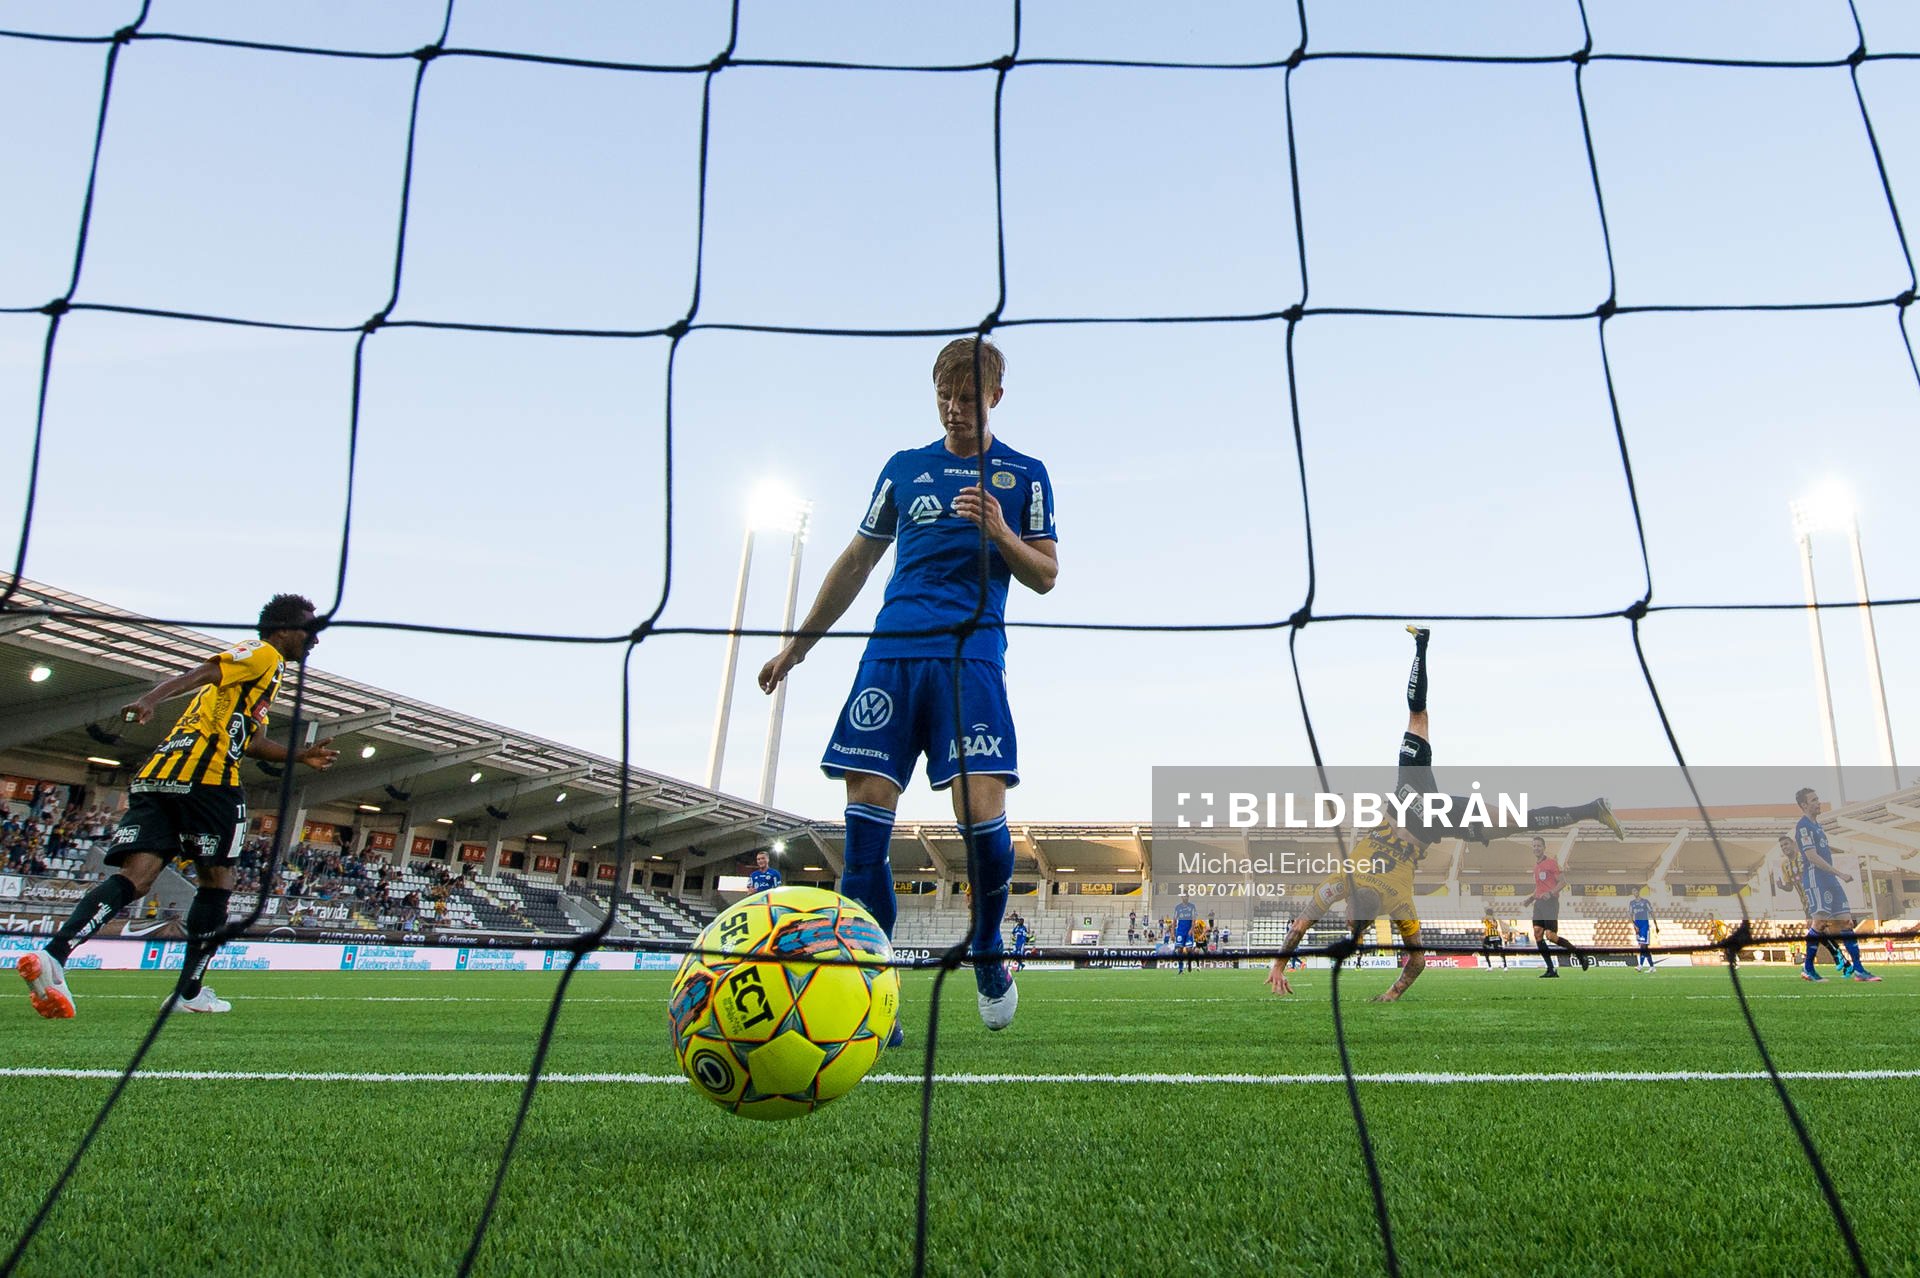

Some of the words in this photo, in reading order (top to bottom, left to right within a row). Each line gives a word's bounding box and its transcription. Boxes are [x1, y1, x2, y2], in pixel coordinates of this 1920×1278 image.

[831, 742, 890, 761] BERNERS
[894, 882, 912, 891] CAB
[1081, 883, 1113, 892] ELCAB
[1425, 957, 1459, 968] candic
